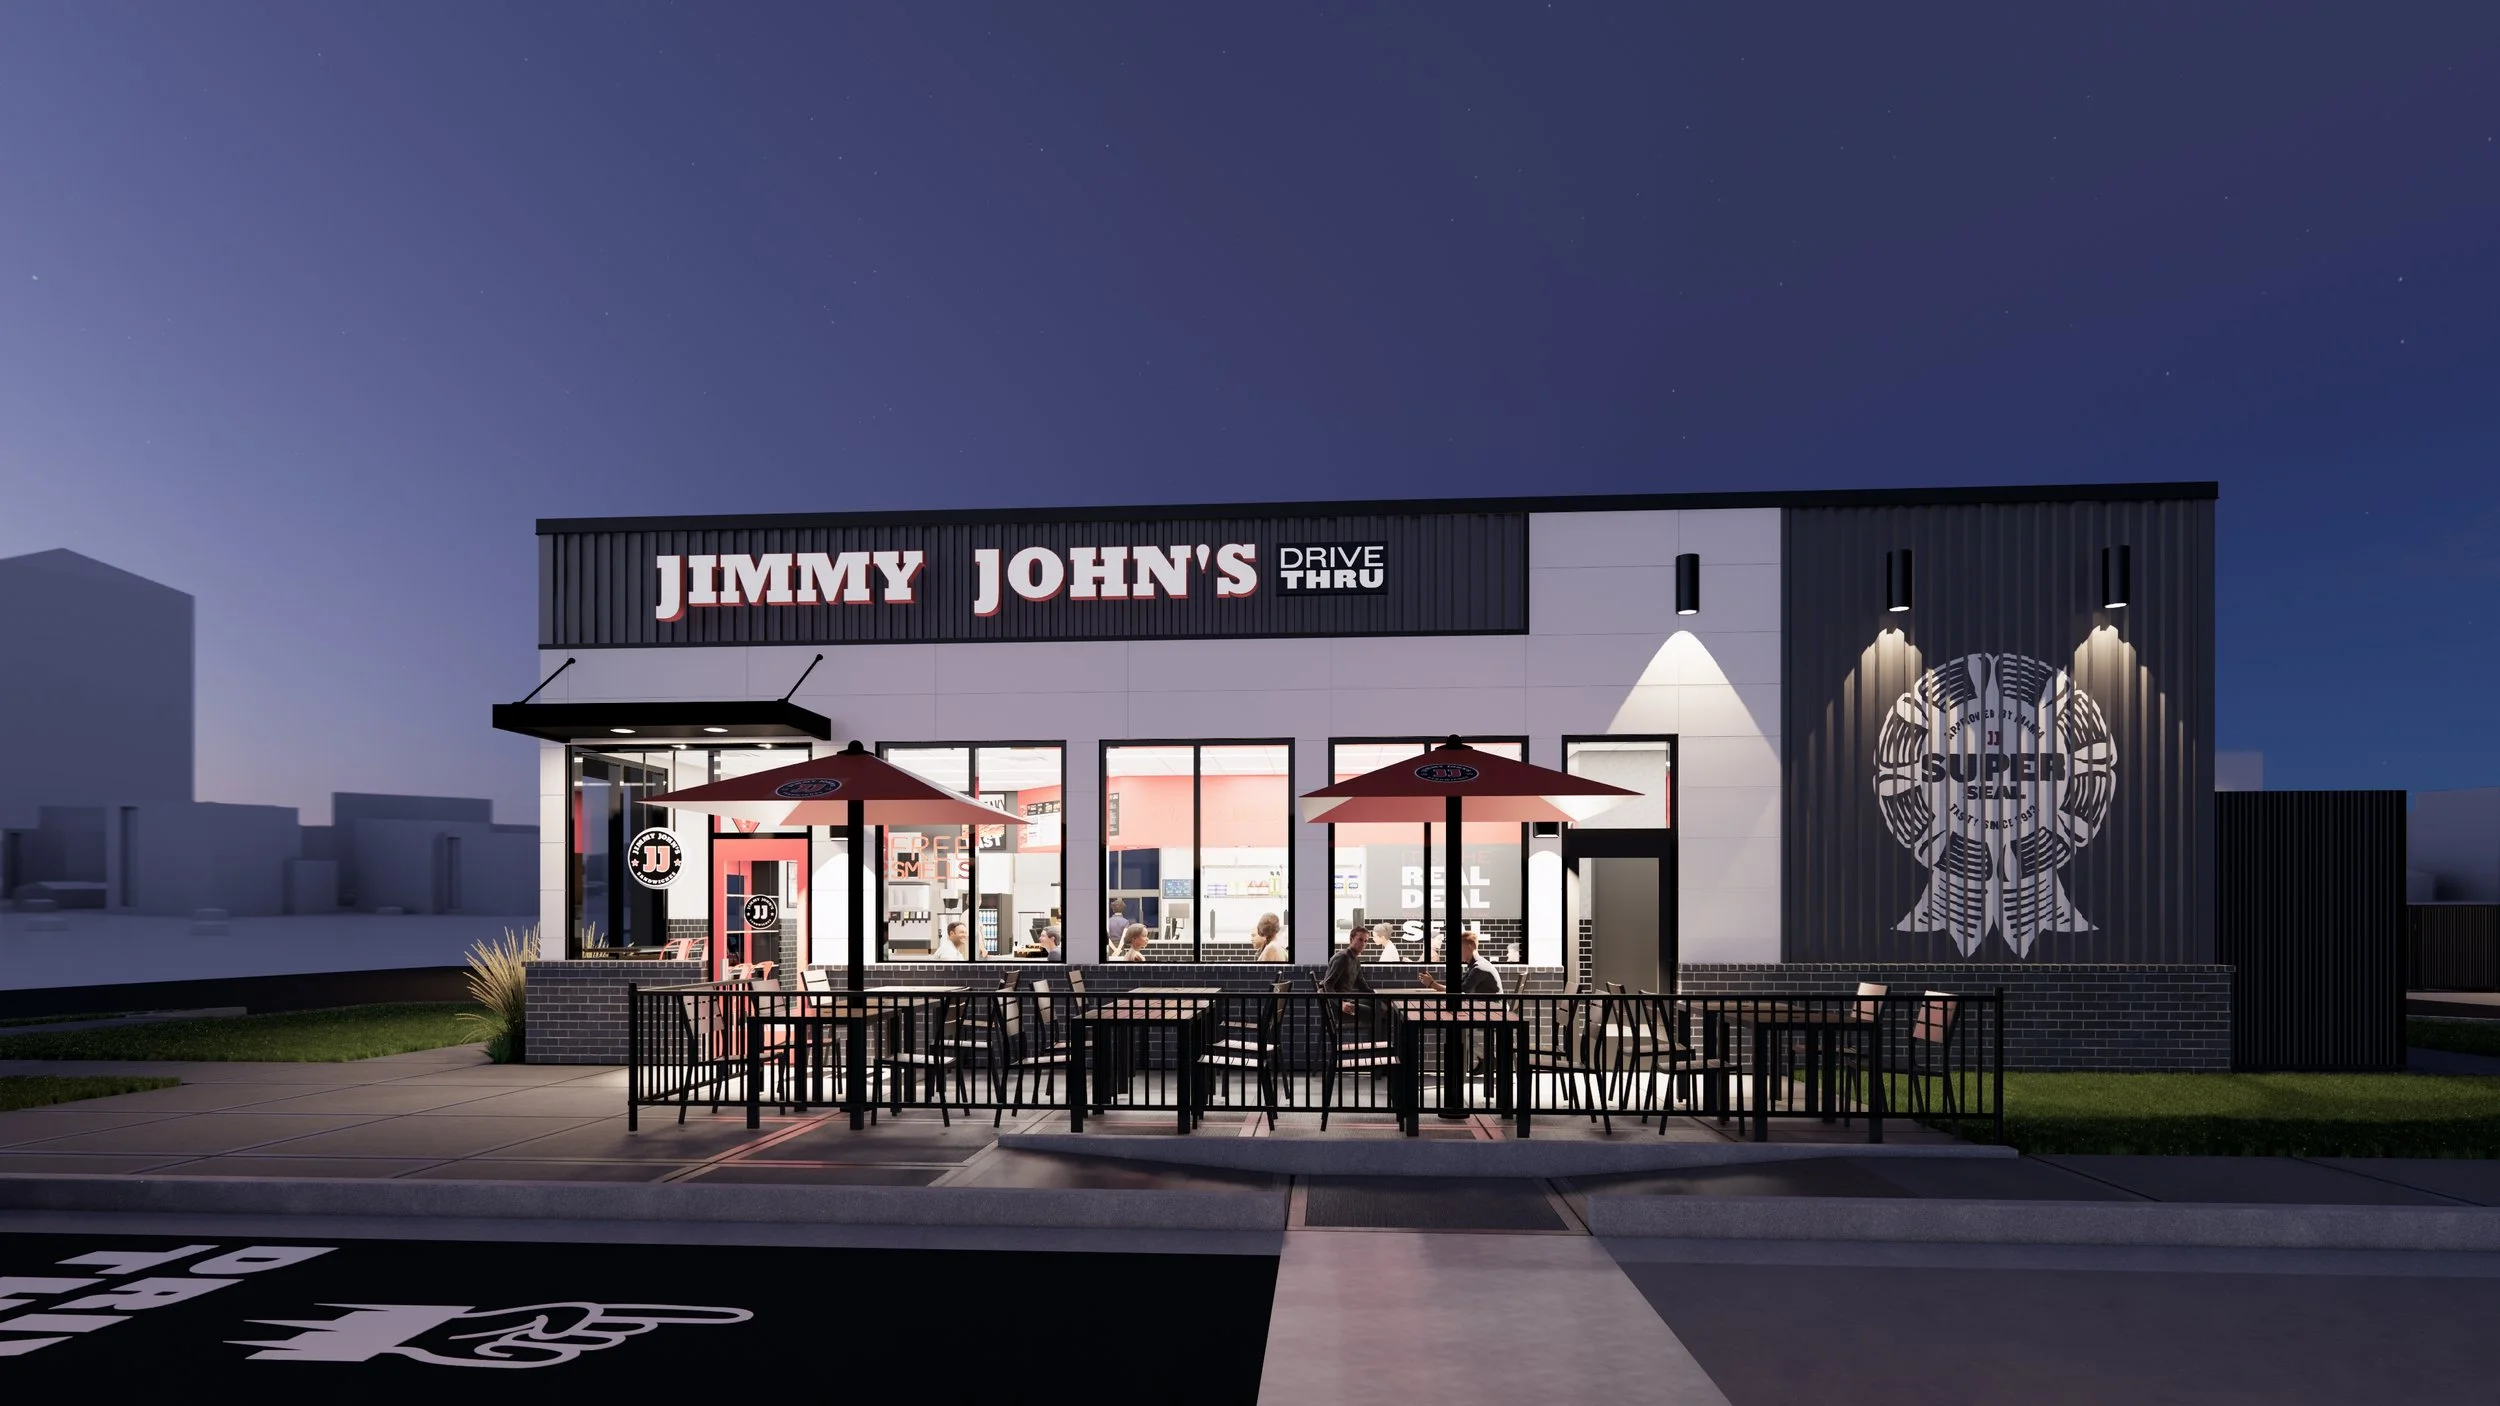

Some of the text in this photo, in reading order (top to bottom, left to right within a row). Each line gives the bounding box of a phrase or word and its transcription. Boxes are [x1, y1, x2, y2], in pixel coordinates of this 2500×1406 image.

[1280, 545, 1385, 570] DRIVE
[656, 544, 1258, 621] JIMMY JOHN'S
[1281, 568, 1385, 591] THRU
[1921, 752, 2066, 783] SUPER
[1962, 785, 2027, 801] SEAL
[1949, 803, 1979, 827] TASTY
[1984, 818, 2014, 831] SINCE
[631, 832, 681, 856] JIMMY JOHN'S
[891, 836, 969, 862] FREE
[642, 845, 671, 873] JJ
[891, 860, 969, 880] SMELLS
[636, 871, 676, 885] SANDWICHES
[752, 904, 768, 920] JJ
